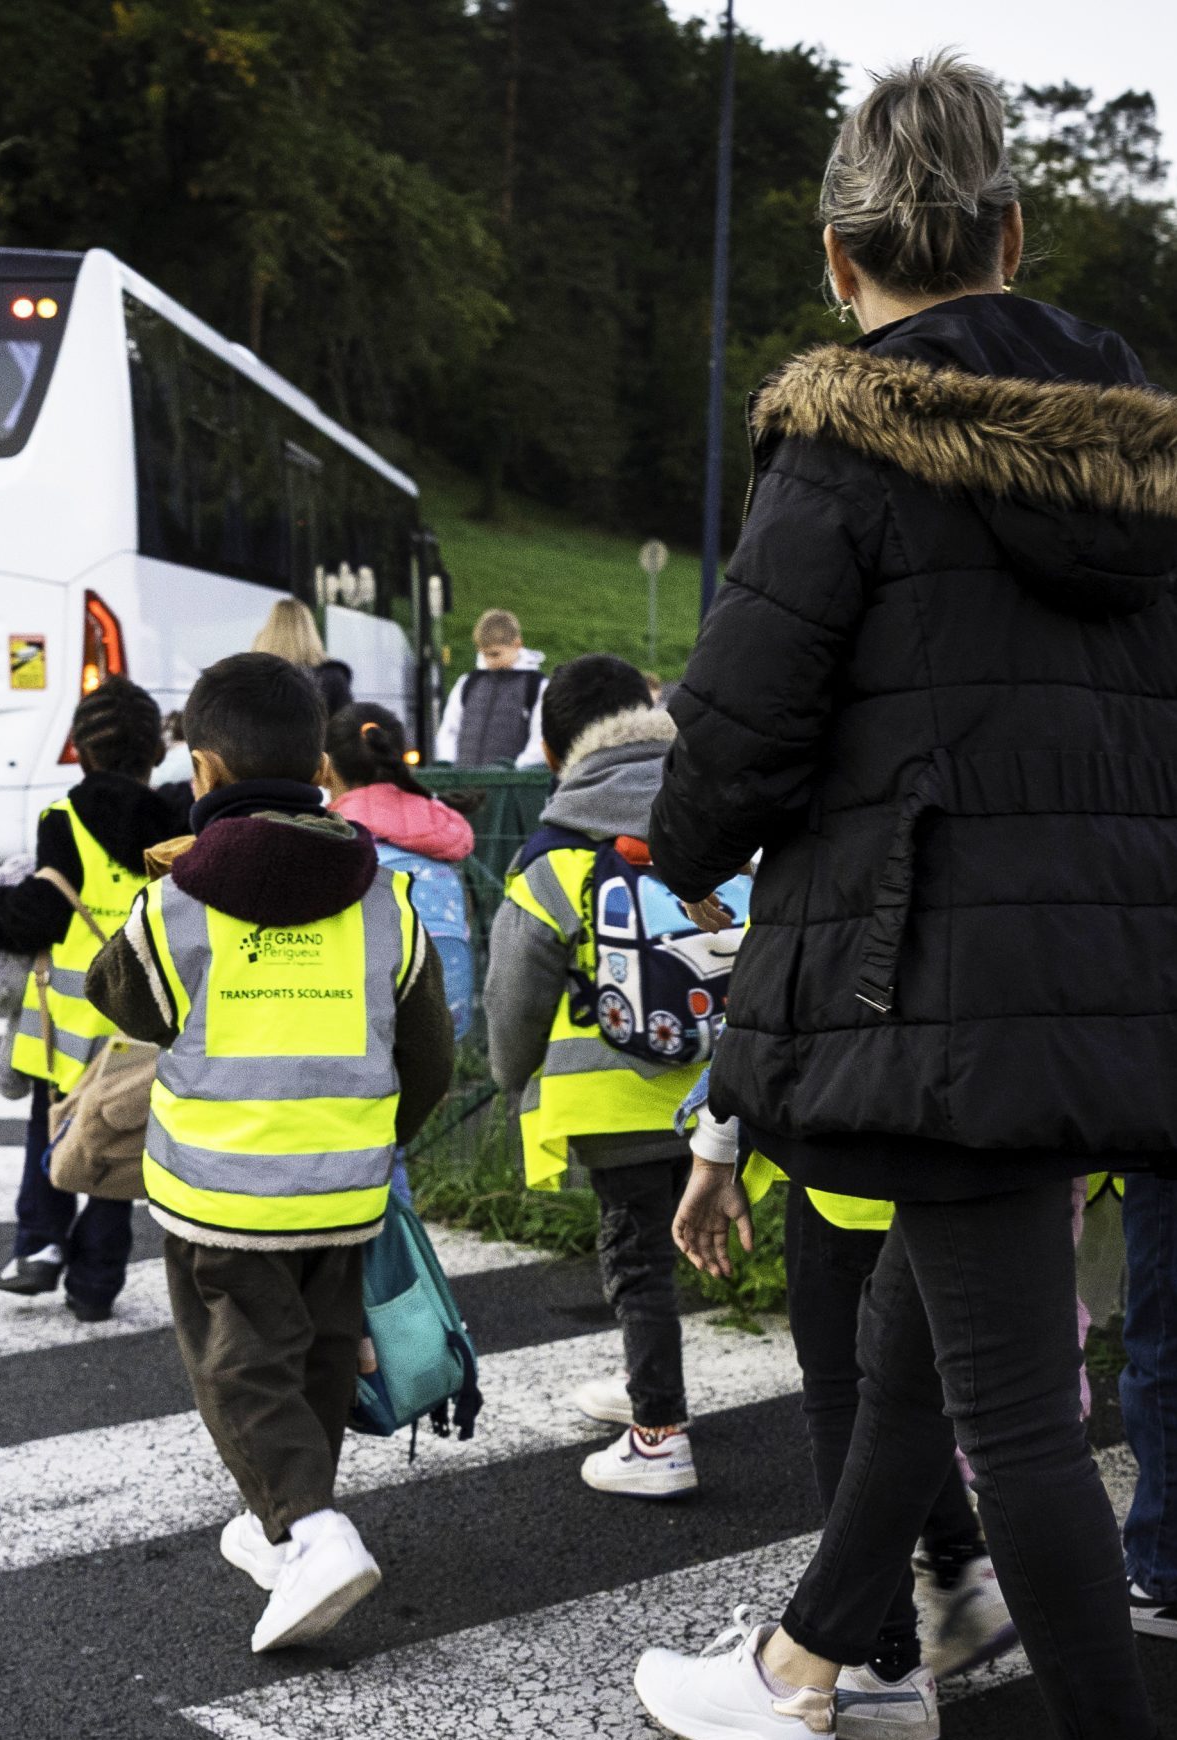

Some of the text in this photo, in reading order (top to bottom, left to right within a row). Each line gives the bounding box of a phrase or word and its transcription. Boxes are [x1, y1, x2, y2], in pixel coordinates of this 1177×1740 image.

[275, 932, 323, 945] GRAND
[220, 989, 353, 999] TRANSPORTS SCOLAIRES
